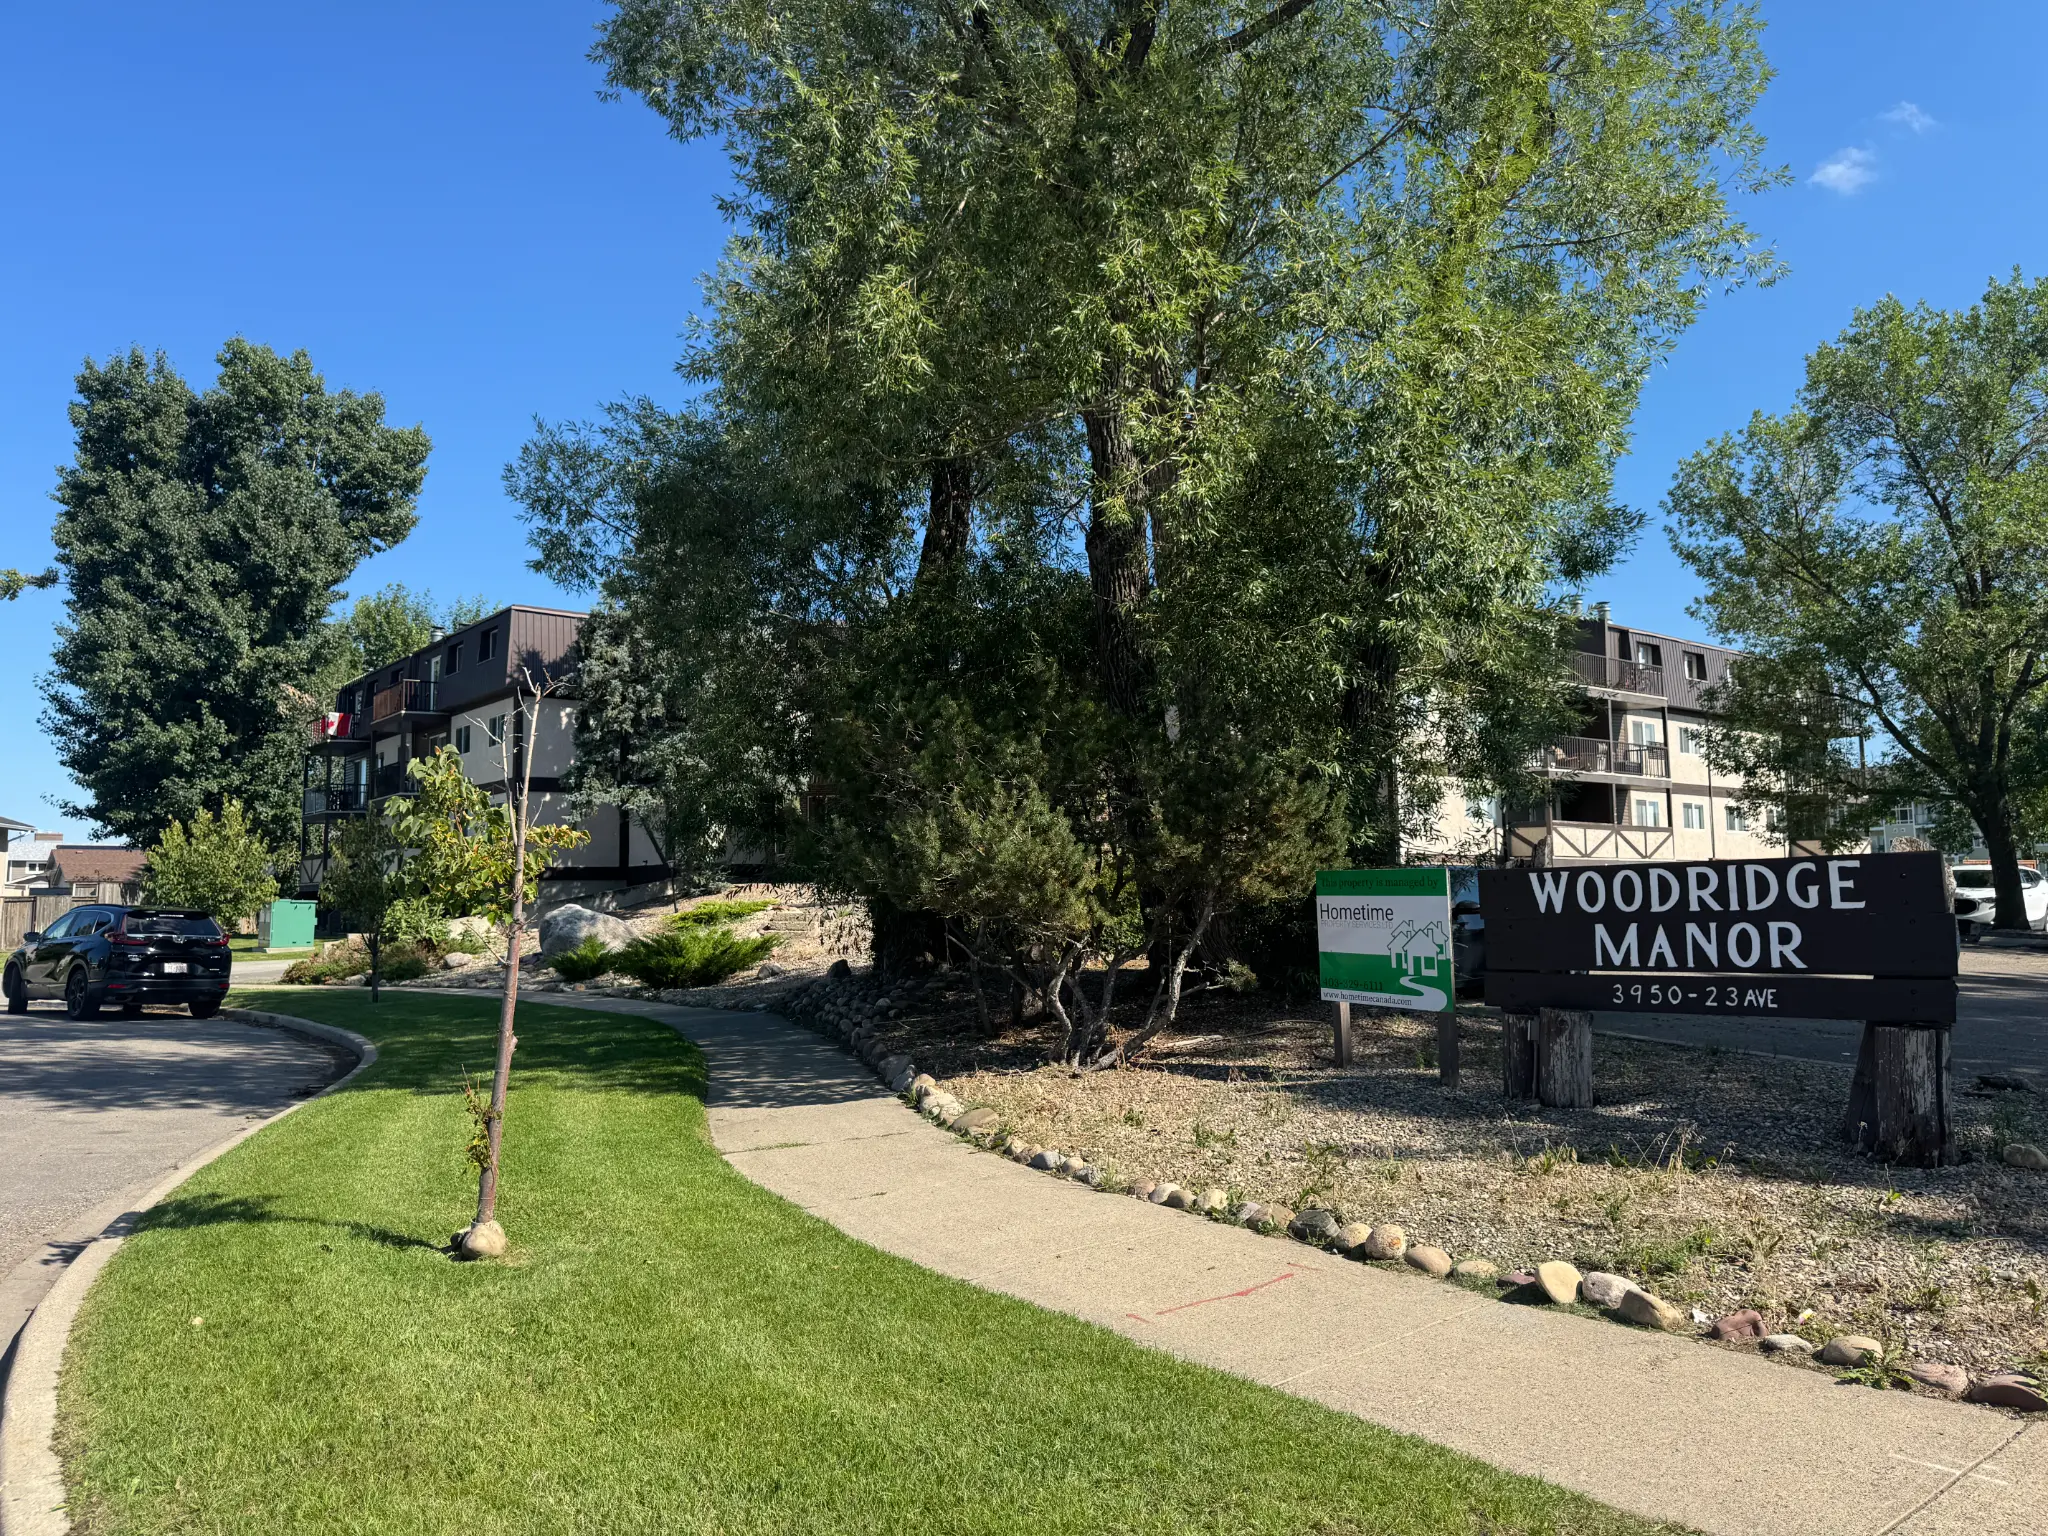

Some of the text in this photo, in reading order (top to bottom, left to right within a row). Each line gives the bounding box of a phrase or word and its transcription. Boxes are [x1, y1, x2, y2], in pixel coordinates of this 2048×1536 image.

[1339, 878, 1374, 890] property
[1376, 877, 1383, 887] is
[1385, 876, 1425, 890] managed
[1427, 876, 1438, 889] by
[1528, 860, 1866, 914] WOODRIDGE
[1320, 903, 1394, 921] Hometime
[1321, 920, 1393, 930] PROPERTY SERVICES LTD
[1594, 921, 1808, 969] MANOR
[1323, 990, 1412, 1006] www.hometimecanada.com
[1744, 988, 1779, 1009] AVE
